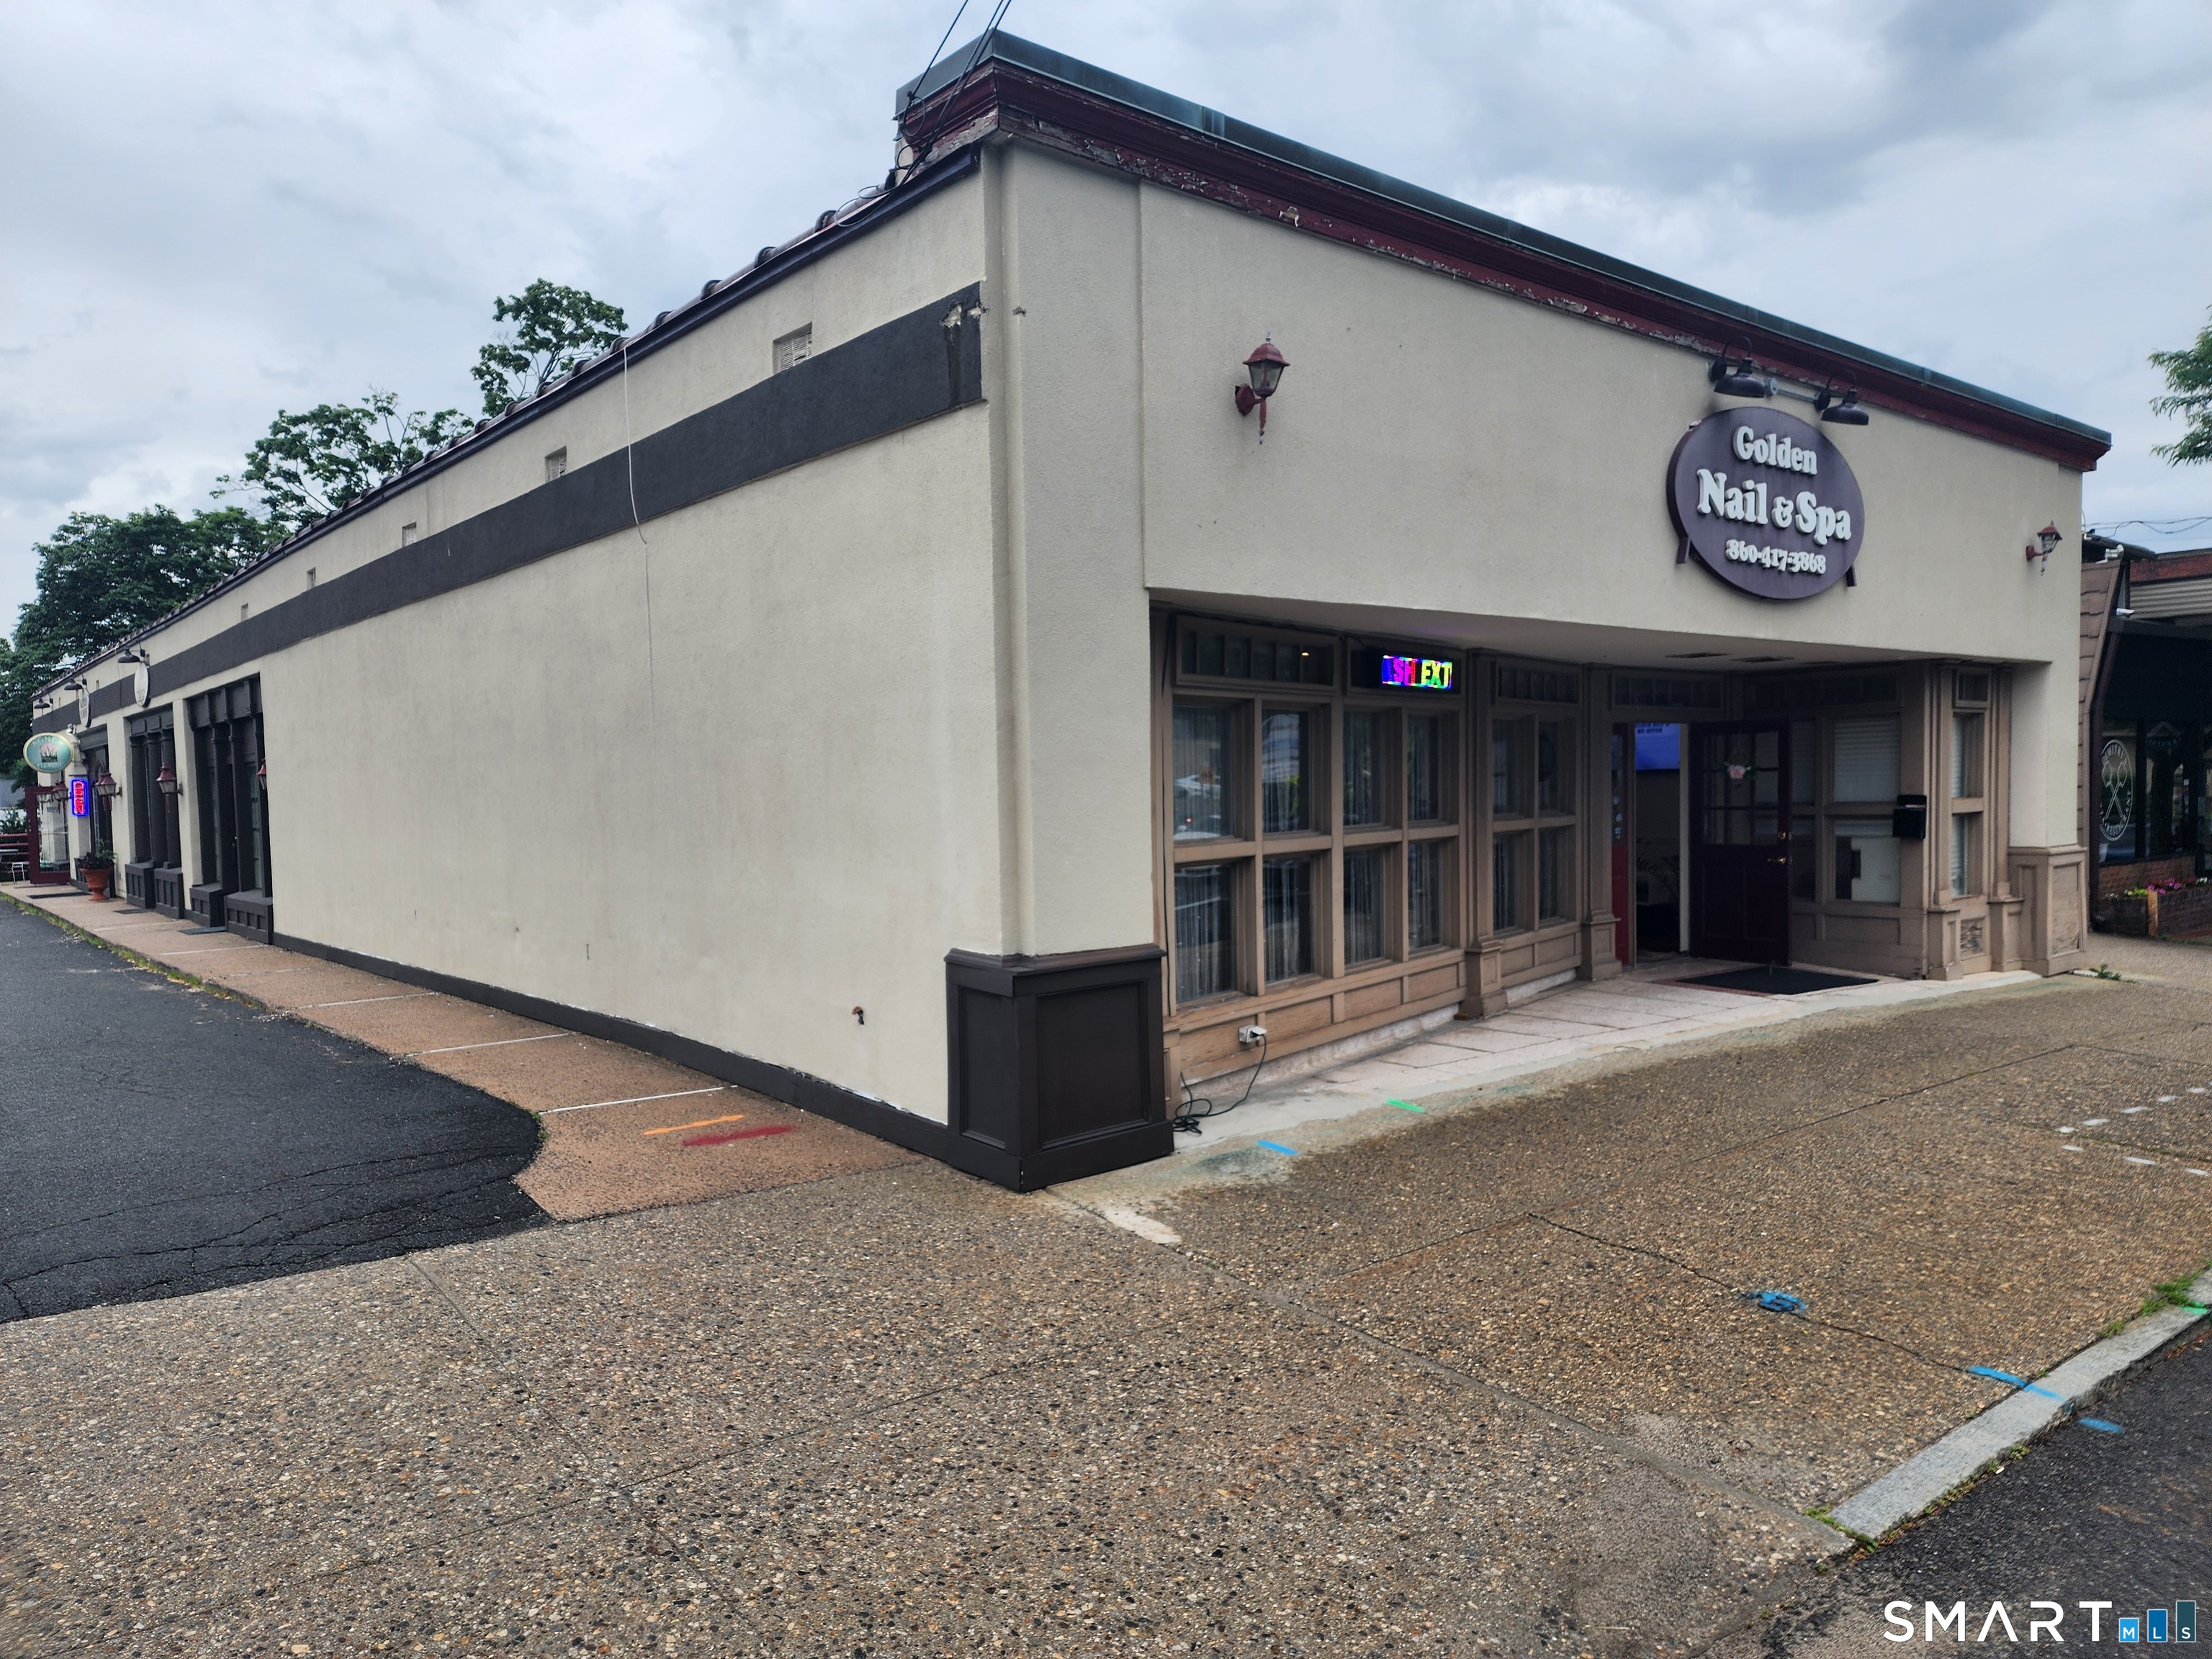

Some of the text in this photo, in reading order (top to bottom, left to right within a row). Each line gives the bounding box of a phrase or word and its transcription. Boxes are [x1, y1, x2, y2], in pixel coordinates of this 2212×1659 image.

[1732, 426, 1817, 475] Golden
[1696, 469, 1851, 545] Nail & Spa
[1726, 539, 1826, 574] 860-417-3868
[1421, 661, 1452, 687] EXT
